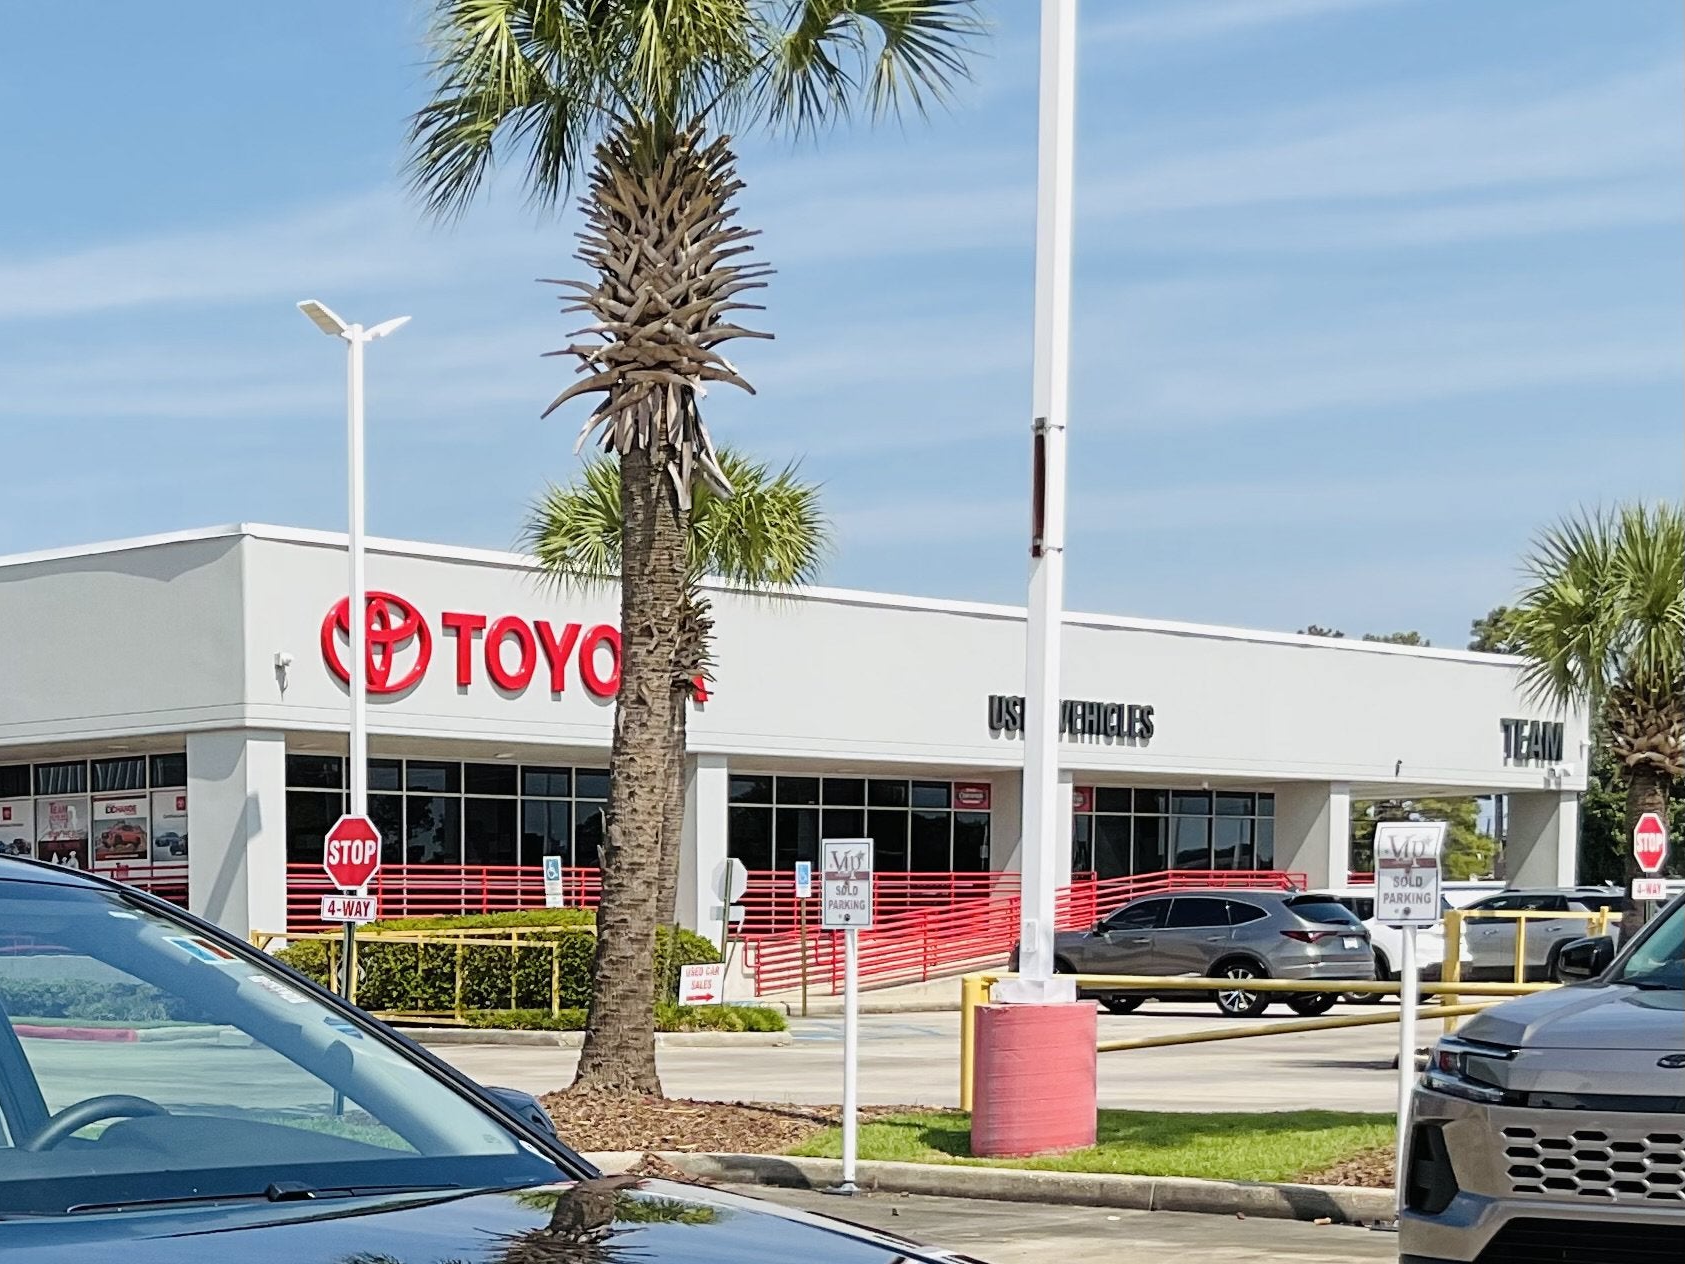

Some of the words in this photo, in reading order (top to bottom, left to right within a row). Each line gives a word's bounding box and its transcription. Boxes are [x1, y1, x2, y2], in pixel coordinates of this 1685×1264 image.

[442, 612, 708, 702] TOYO
[1500, 718, 1564, 761] TEAM
[1637, 832, 1663, 853] STOP
[328, 840, 377, 865] STOP
[1393, 875, 1423, 888] SOLD
[836, 885, 858, 896] SOLD
[1637, 882, 1661, 895] 4-WAY
[1383, 892, 1432, 904] PARKING
[327, 900, 371, 917] 4-WAY
[828, 899, 866, 911] PARKING
[691, 980, 713, 990] SALES
